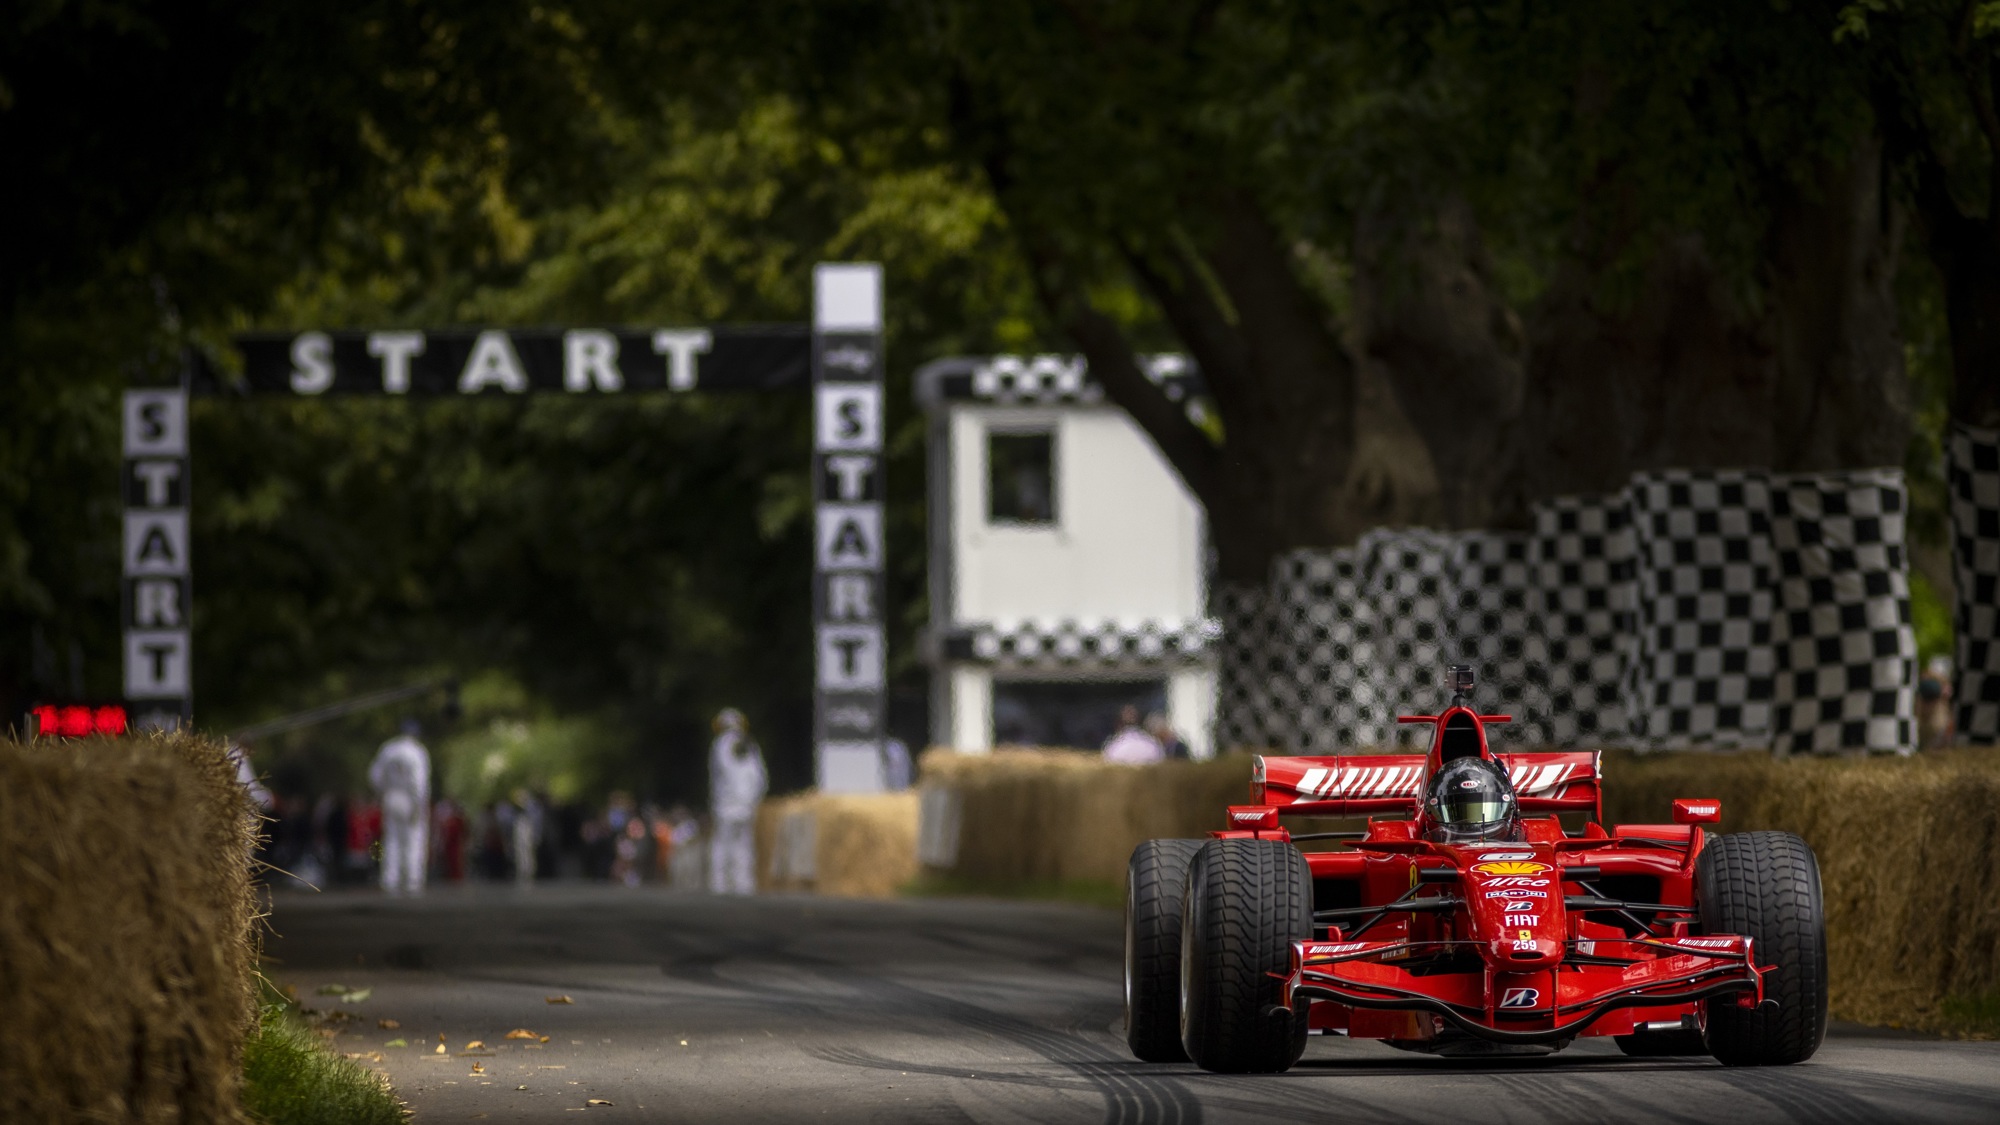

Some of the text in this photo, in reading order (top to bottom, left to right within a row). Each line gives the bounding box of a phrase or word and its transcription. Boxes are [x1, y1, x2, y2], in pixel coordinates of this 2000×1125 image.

[289, 329, 713, 395] START
[133, 401, 183, 684] START
[827, 397, 877, 679] START
[1480, 877, 1550, 887] Alice
[1504, 914, 1540, 927] FIAT
[1512, 939, 1537, 951] 259
